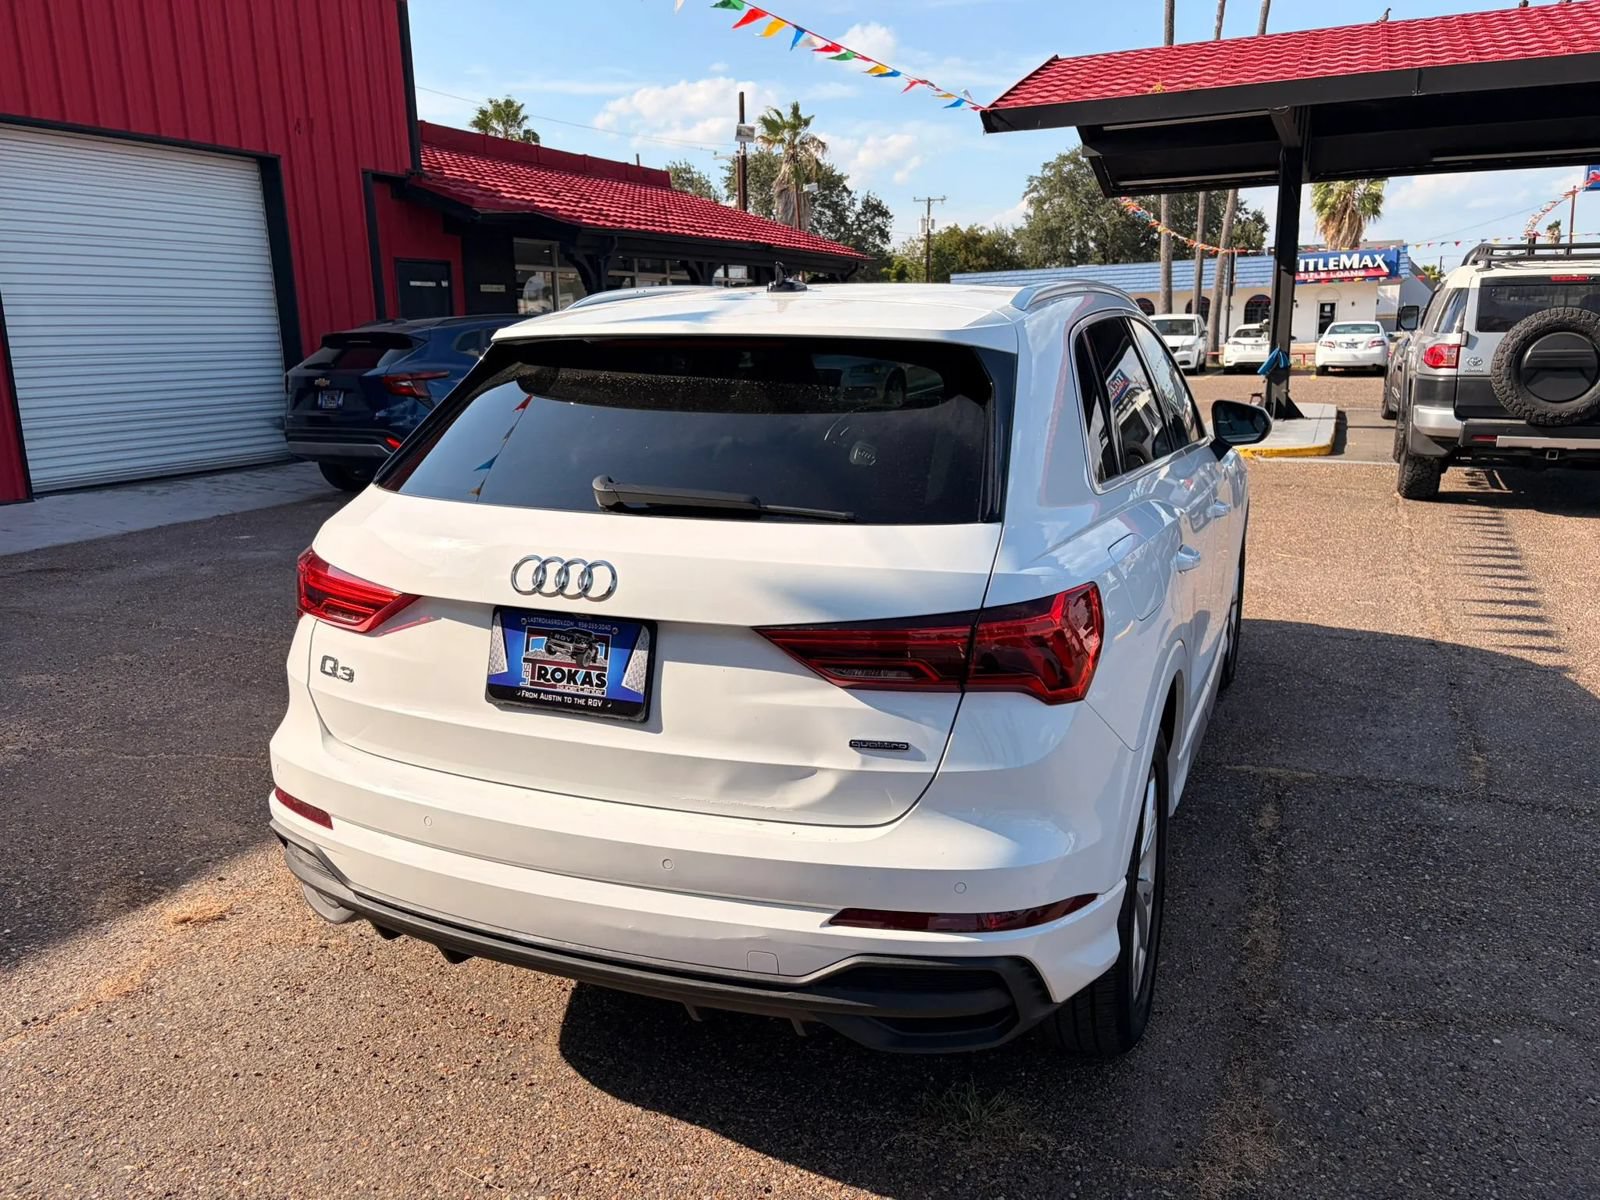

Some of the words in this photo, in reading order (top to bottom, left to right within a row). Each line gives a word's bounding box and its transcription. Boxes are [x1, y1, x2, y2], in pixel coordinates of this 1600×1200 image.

[1297, 253, 1390, 272] ITLEMAX
[320, 654, 355, 683] Q3
[525, 658, 607, 688] TROKAS
[539, 691, 562, 702] AUSTIN
[587, 698, 603, 708] RGV
[851, 740, 908, 750] quattro
